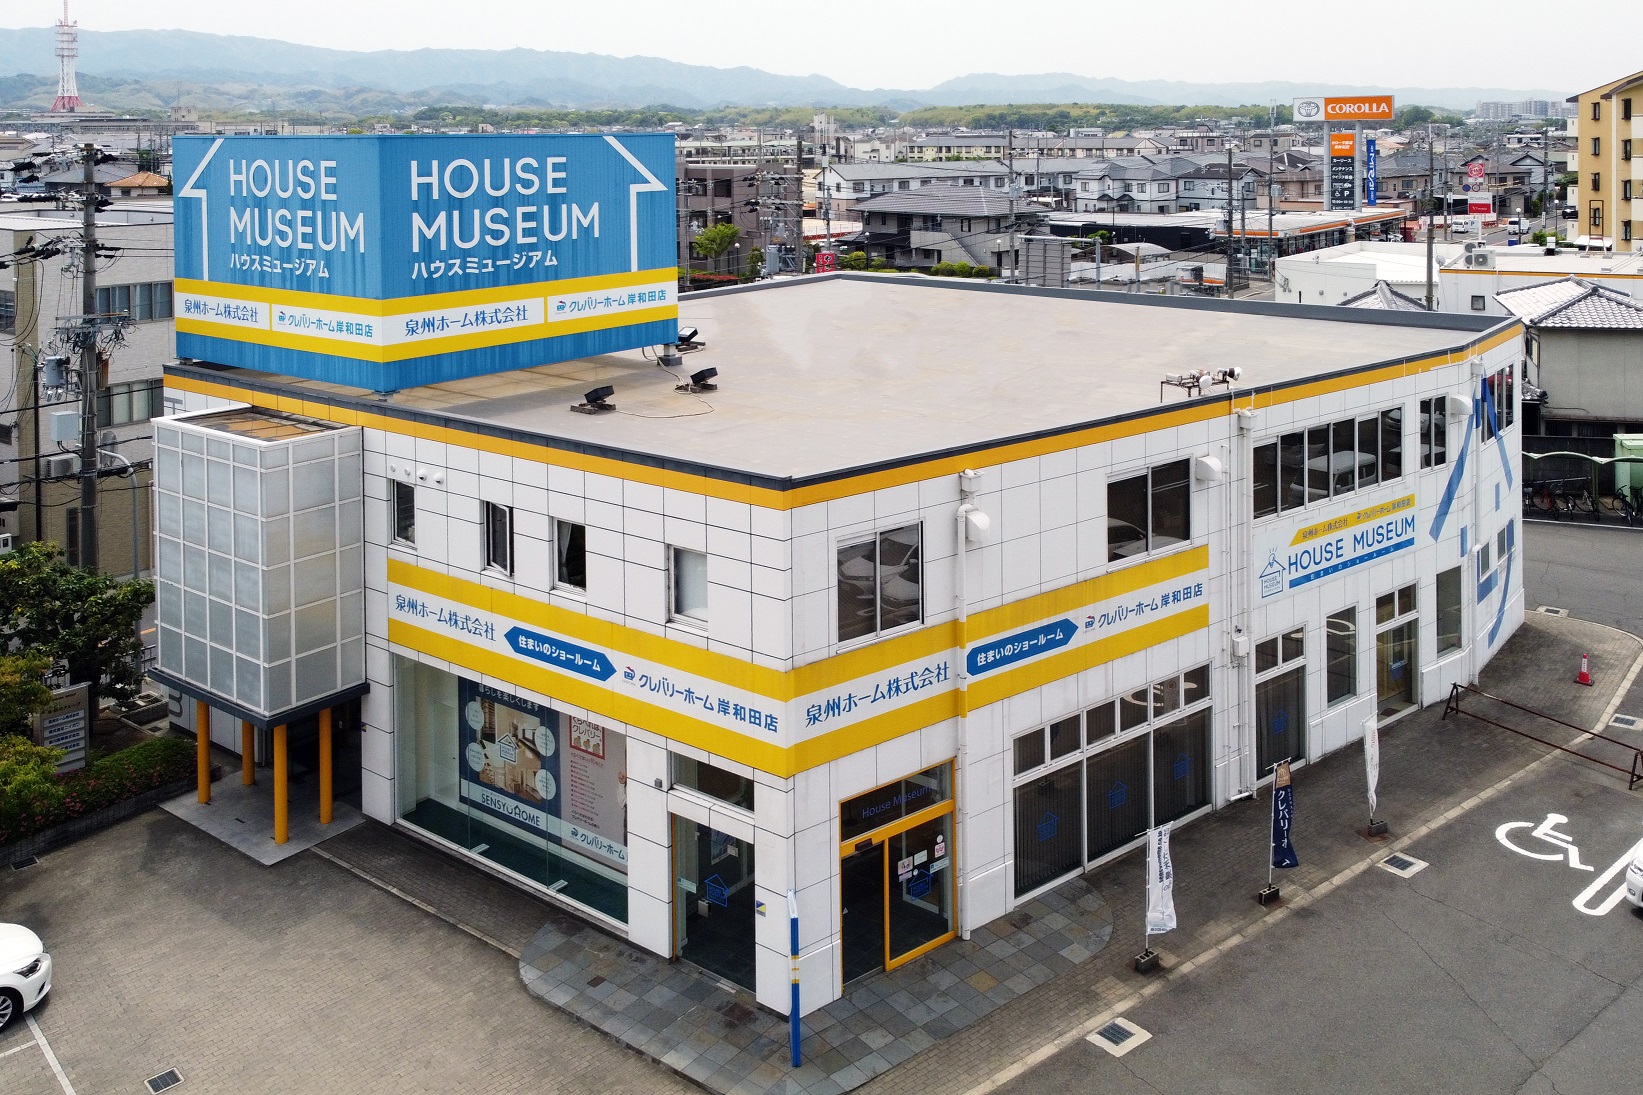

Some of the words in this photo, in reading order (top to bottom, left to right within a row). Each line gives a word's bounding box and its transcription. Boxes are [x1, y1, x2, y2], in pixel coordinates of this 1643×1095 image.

[1327, 102, 1389, 114] COROLLA
[229, 159, 337, 201] HOUSE
[411, 156, 567, 201] HOUSE
[229, 207, 365, 253] MUSEUM
[412, 201, 600, 253] MUSEUM
[230, 252, 329, 279] ハウスミュージアム
[412, 249, 558, 279] ハウスミュージアム
[184, 299, 259, 323] 泉州ホーム株式会社
[405, 304, 528, 337] 泉州ホーム株式会社
[1288, 538, 1343, 575] HOUSE
[1354, 515, 1415, 553] MUSEUM
[396, 594, 496, 641] 泉州ホーム株式会社
[519, 635, 600, 672] 住まいのショールーム
[977, 628, 1063, 666] 住まいのショールーム
[805, 660, 950, 728] 泉州ホーム株式会社
[862, 802, 891, 819] House
[893, 786, 932, 807] Museum
